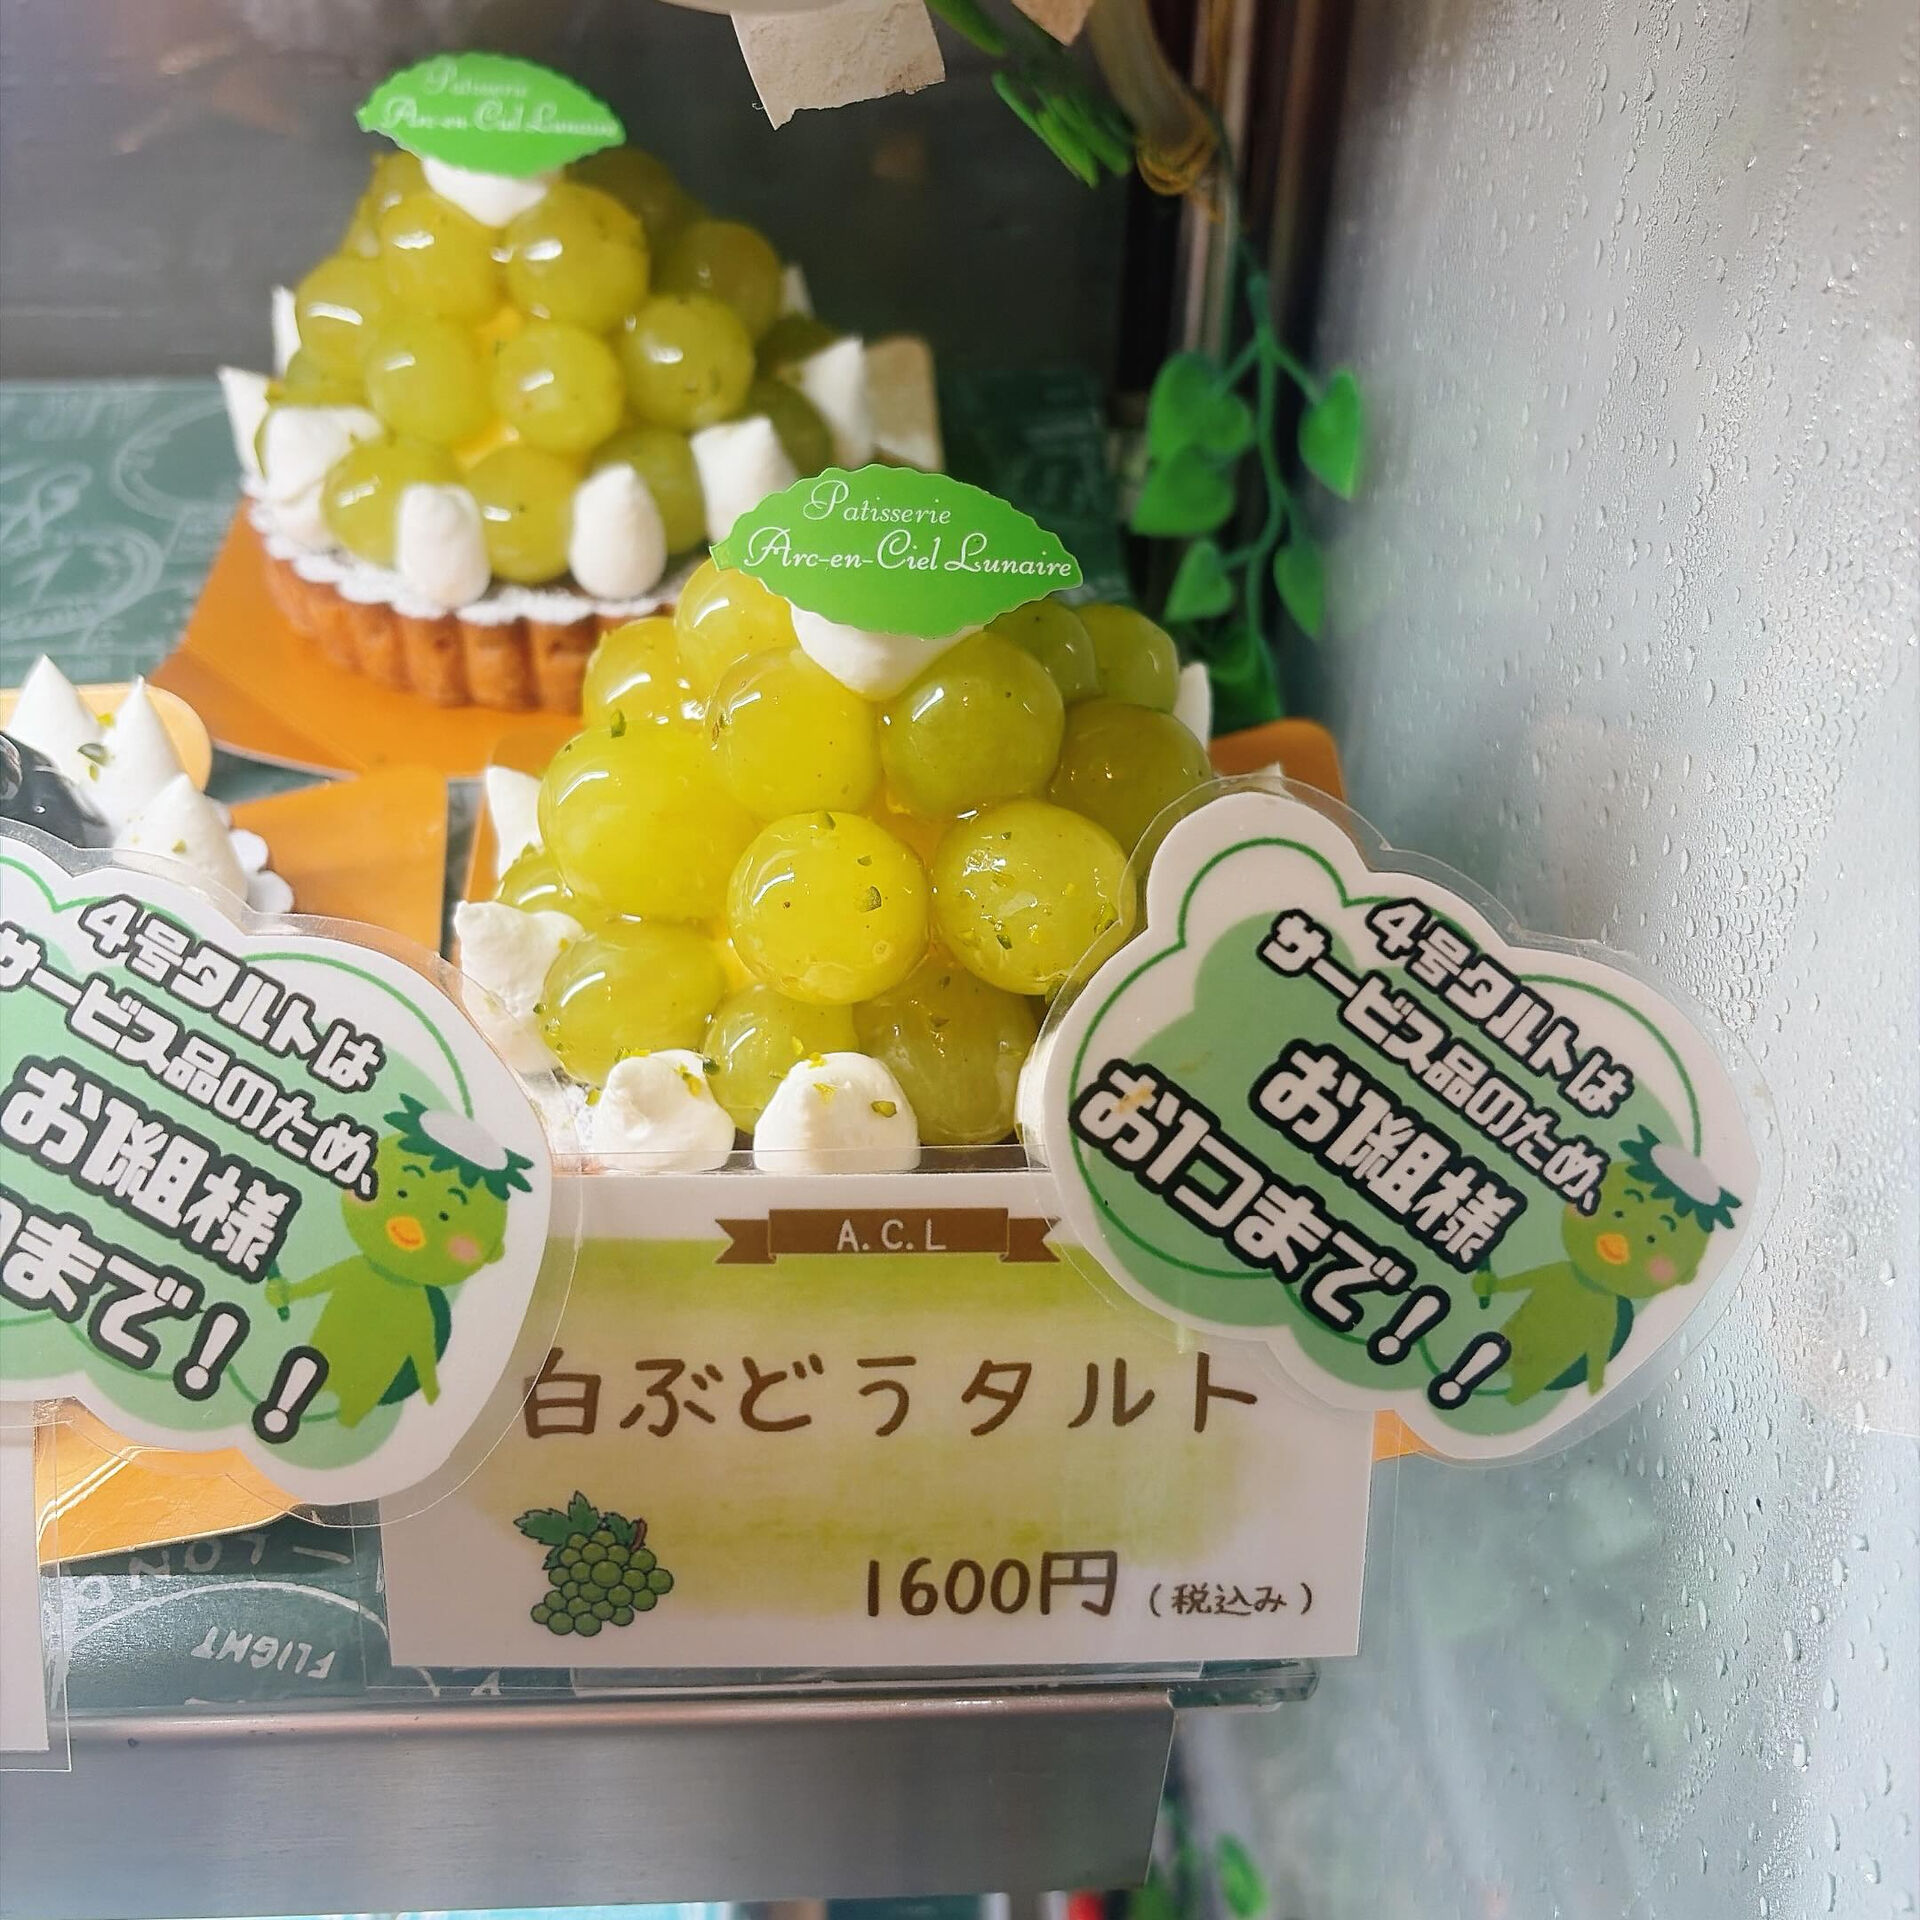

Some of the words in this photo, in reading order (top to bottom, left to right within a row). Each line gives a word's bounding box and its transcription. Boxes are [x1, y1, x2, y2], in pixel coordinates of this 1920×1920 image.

[803, 480, 951, 524] Patisserie
[744, 526, 941, 571] Arc-en-Ciel
[944, 533, 1072, 577] Lunaire
[80, 896, 386, 1092] 4号タルトは
[1369, 900, 1632, 1115] 4号タルトは
[1259, 911, 1608, 1212] サービス品のため、
[837, 1218, 947, 1252] A.C.L
[0, 1193, 326, 1440] まで！！
[524, 1346, 1259, 1438] 白ぶどうタルト
[867, 1550, 1118, 1617] 1600円
[191, 1626, 337, 1680] FLIGHT
